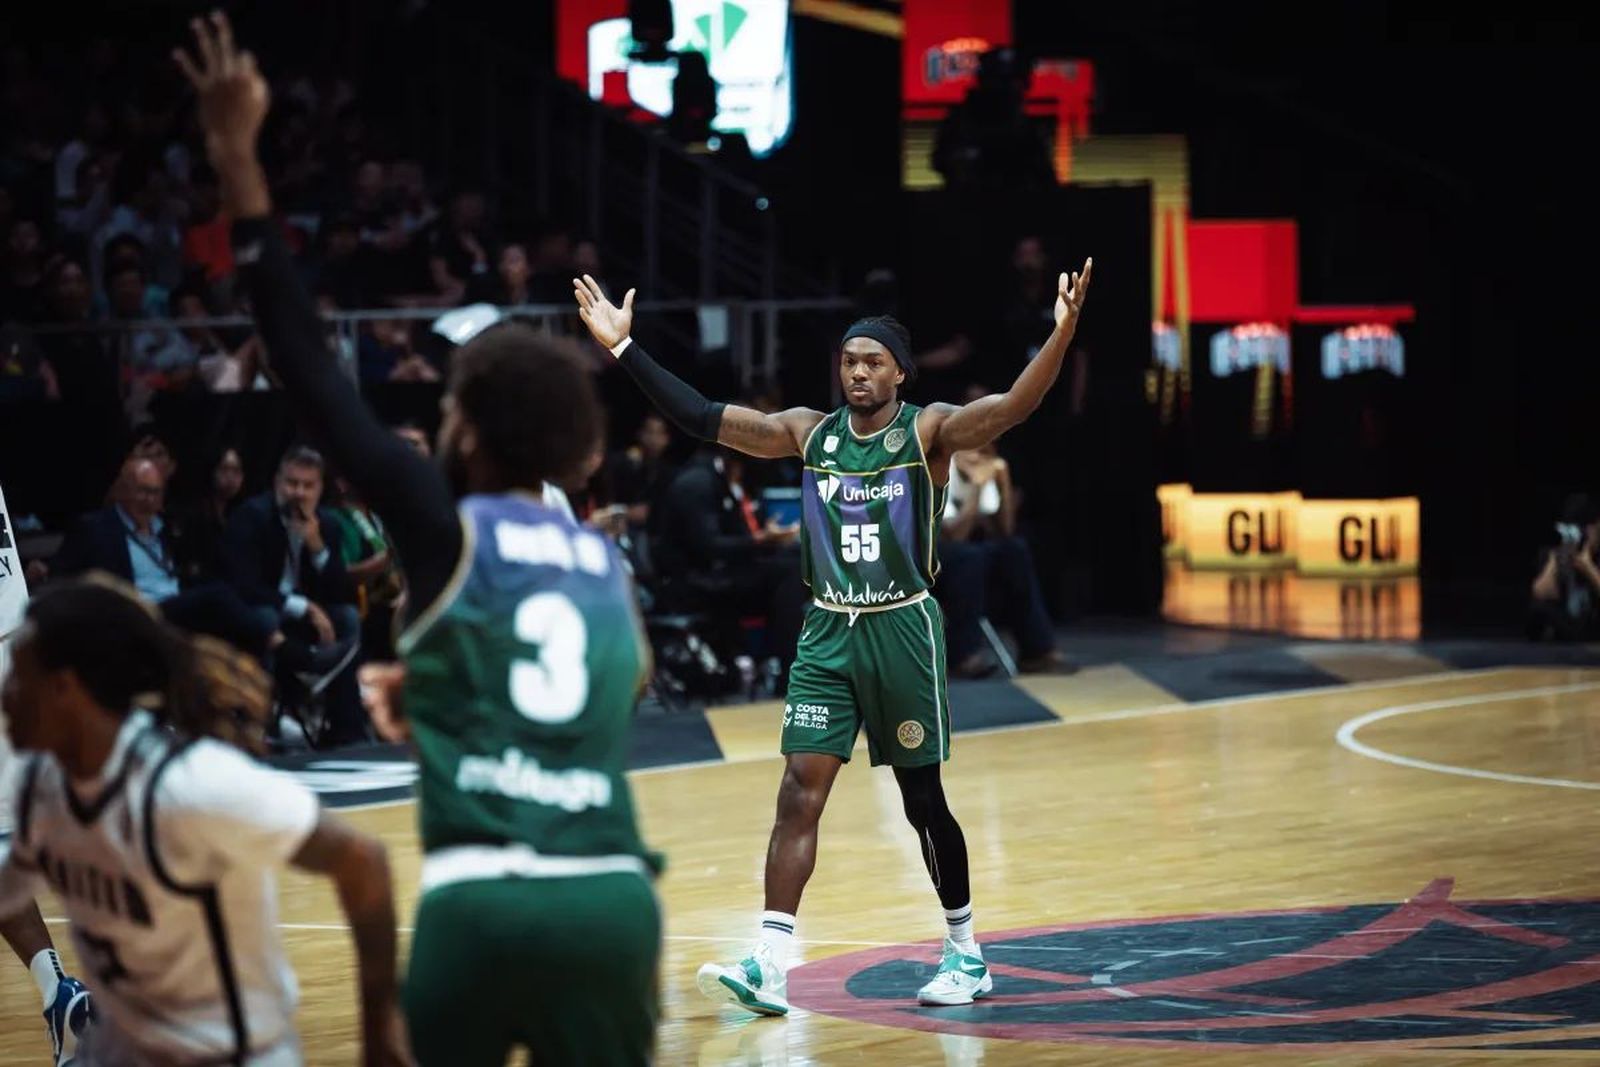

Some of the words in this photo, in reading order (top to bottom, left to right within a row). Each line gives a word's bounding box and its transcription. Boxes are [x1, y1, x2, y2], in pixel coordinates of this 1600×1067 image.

[843, 480, 904, 502] Unicaja
[841, 523, 880, 563] 55
[822, 580, 906, 605] Andalucía
[509, 591, 589, 724] 3
[794, 713, 811, 721] DEL
[811, 714, 829, 723] SOL
[796, 703, 829, 715] COSTA
